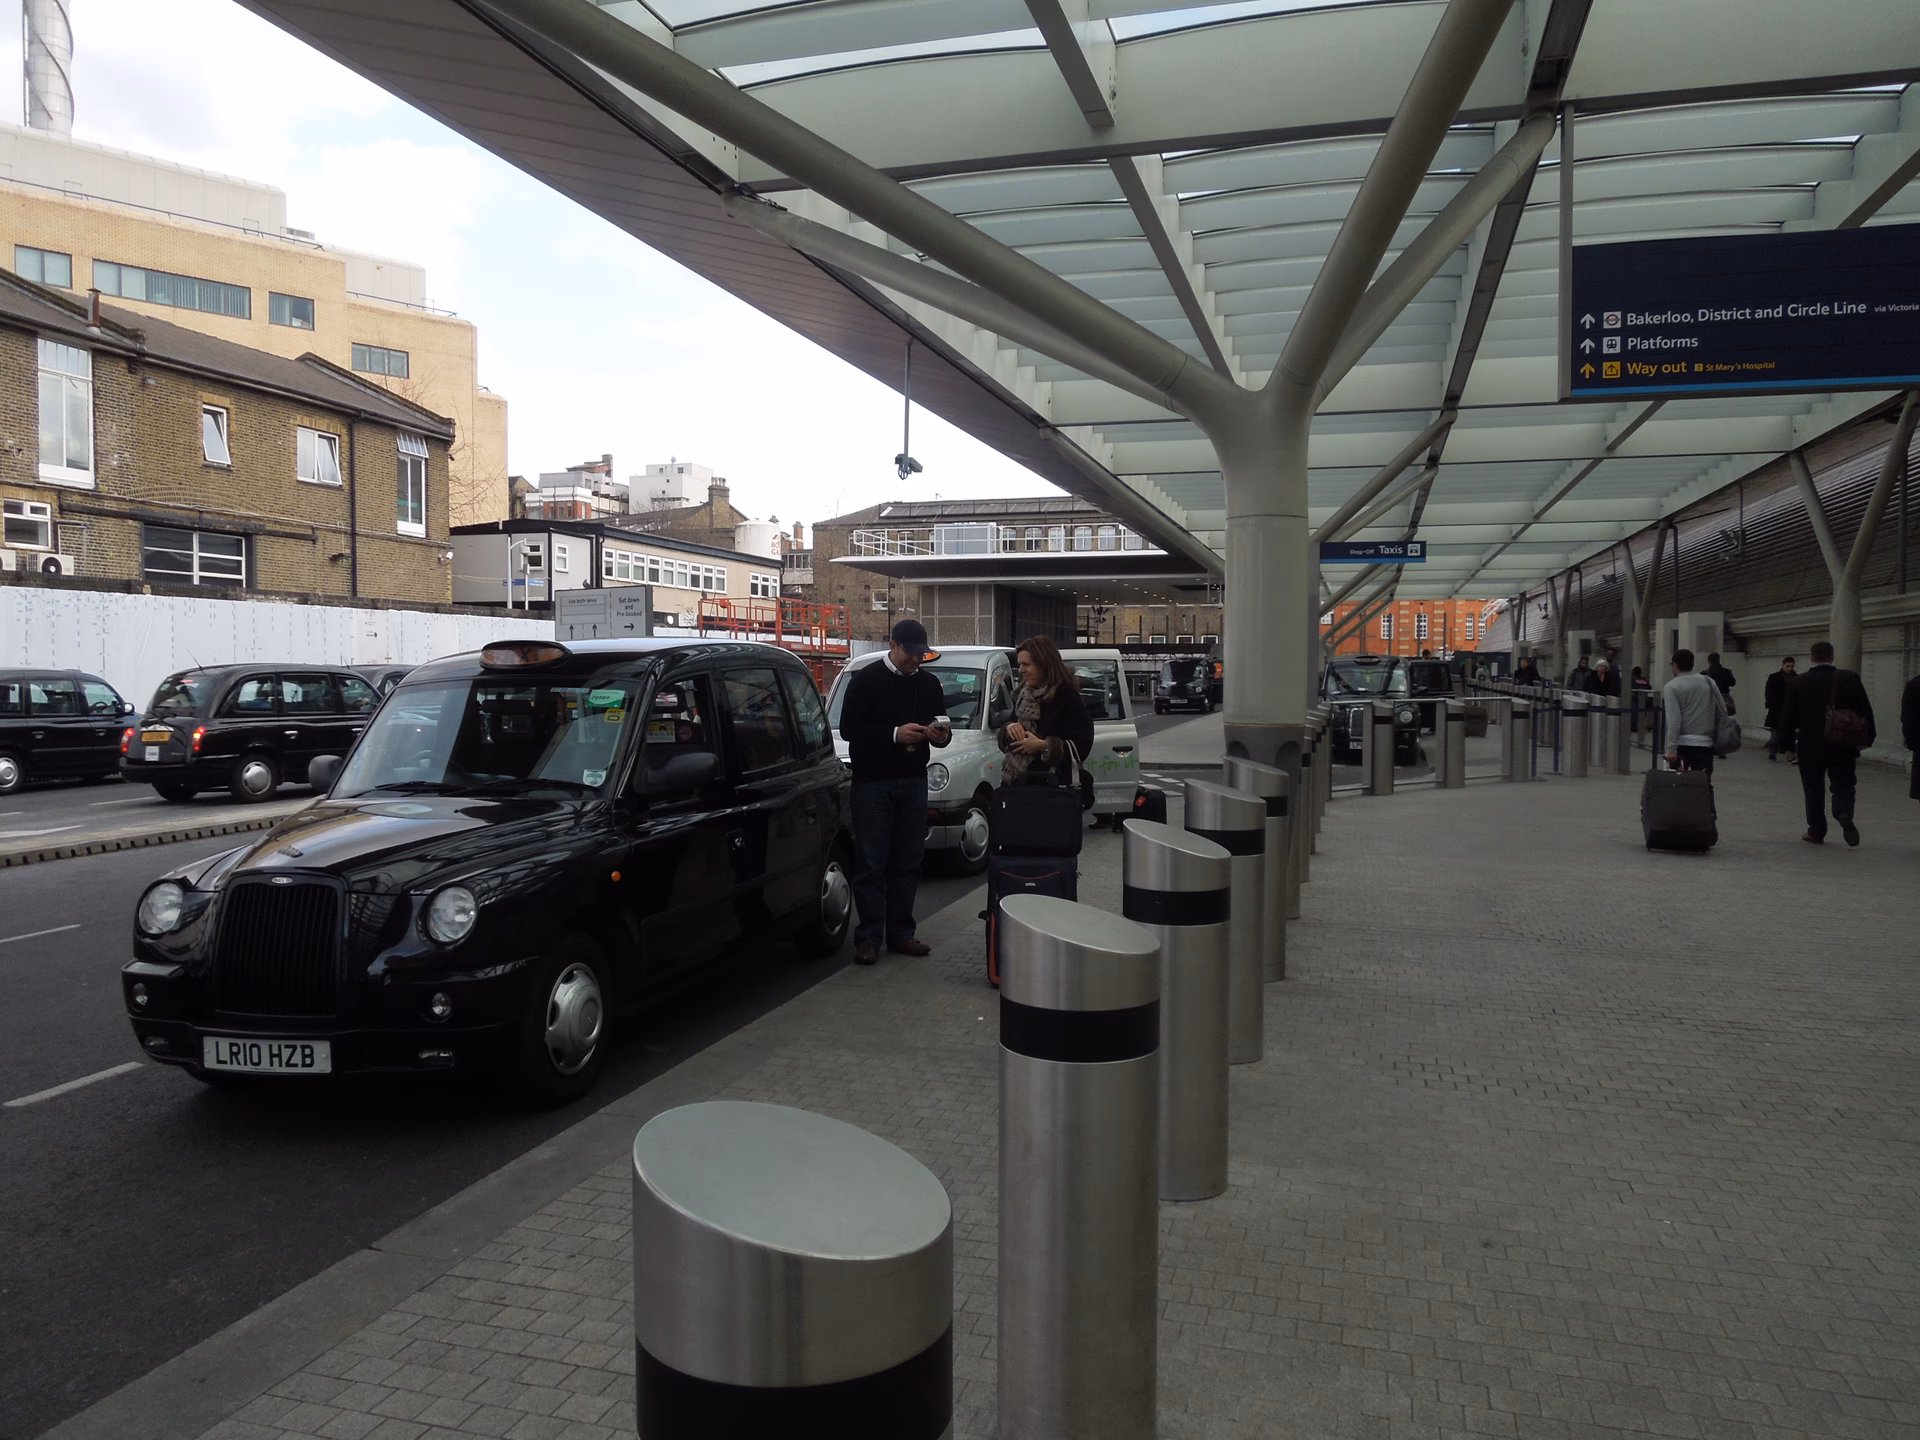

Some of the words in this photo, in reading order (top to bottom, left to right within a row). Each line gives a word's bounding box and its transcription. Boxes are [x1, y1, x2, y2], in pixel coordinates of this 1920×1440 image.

[1627, 311, 1694, 325] Bakerloo,
[1698, 307, 1751, 321] District
[1754, 304, 1783, 319] and
[1787, 303, 1830, 316] Circle
[1834, 301, 1867, 315] Line
[1888, 303, 1920, 312] Victoria
[1627, 336, 1699, 350] Platforms
[1627, 362, 1657, 376] Way
[1662, 361, 1687, 373] out
[1715, 363, 1741, 372] Mary's
[1742, 361, 1775, 370] Hospital
[1379, 545, 1403, 554] Taxis
[215, 1041, 262, 1066] LR10
[268, 1044, 315, 1068] HZB
